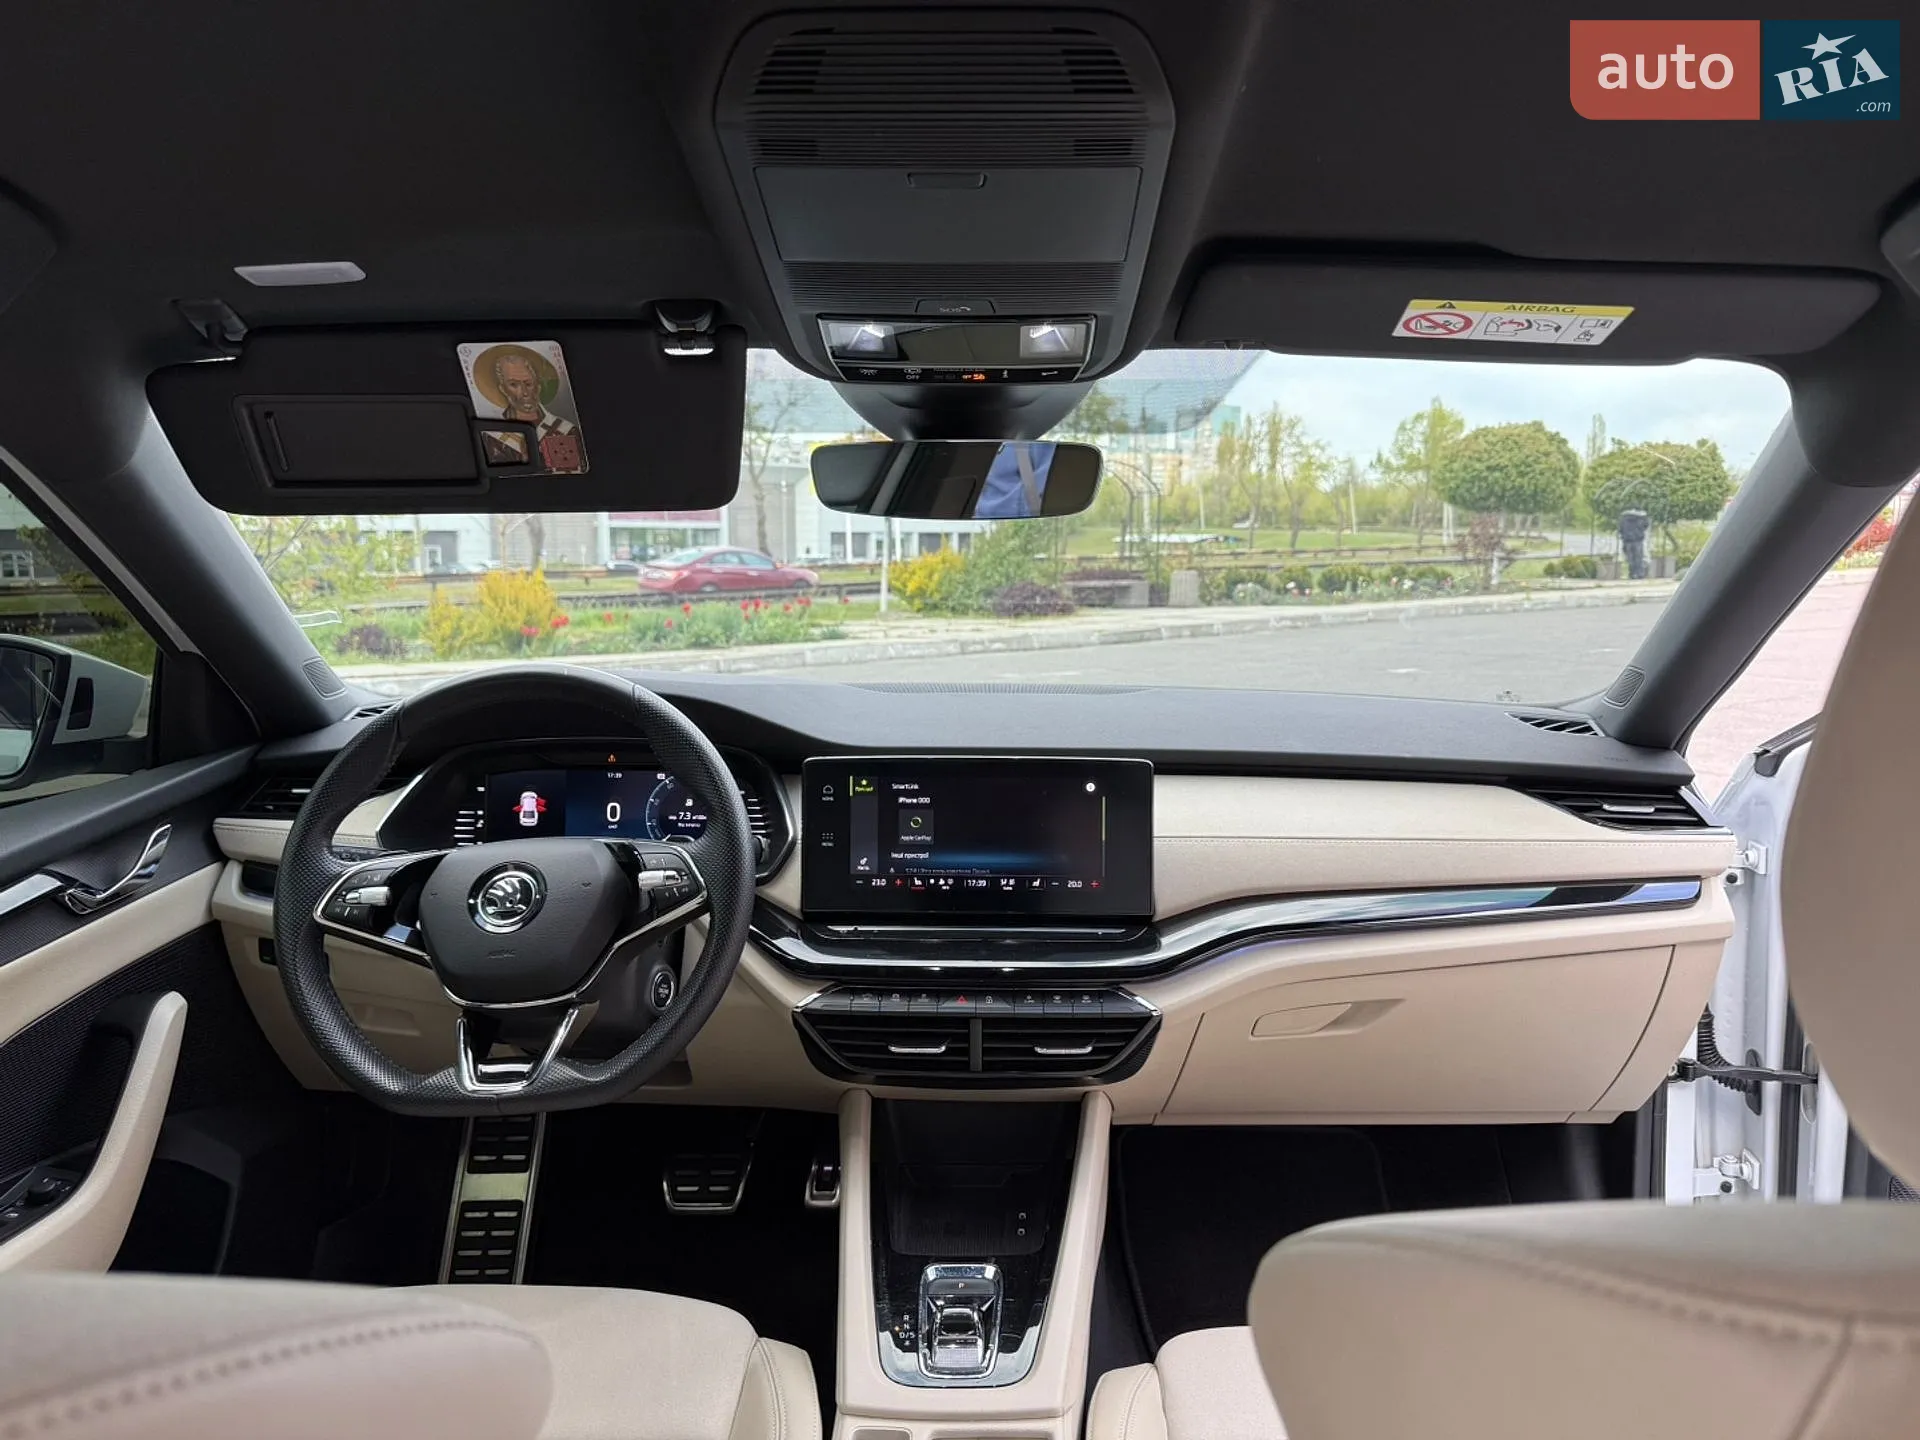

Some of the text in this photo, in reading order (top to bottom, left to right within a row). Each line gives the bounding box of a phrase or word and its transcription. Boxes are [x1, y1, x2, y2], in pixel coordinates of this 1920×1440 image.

[1503, 304, 1577, 313] AIRBAG
[607, 802, 621, 823] 0
[678, 811, 692, 821] 7.3
